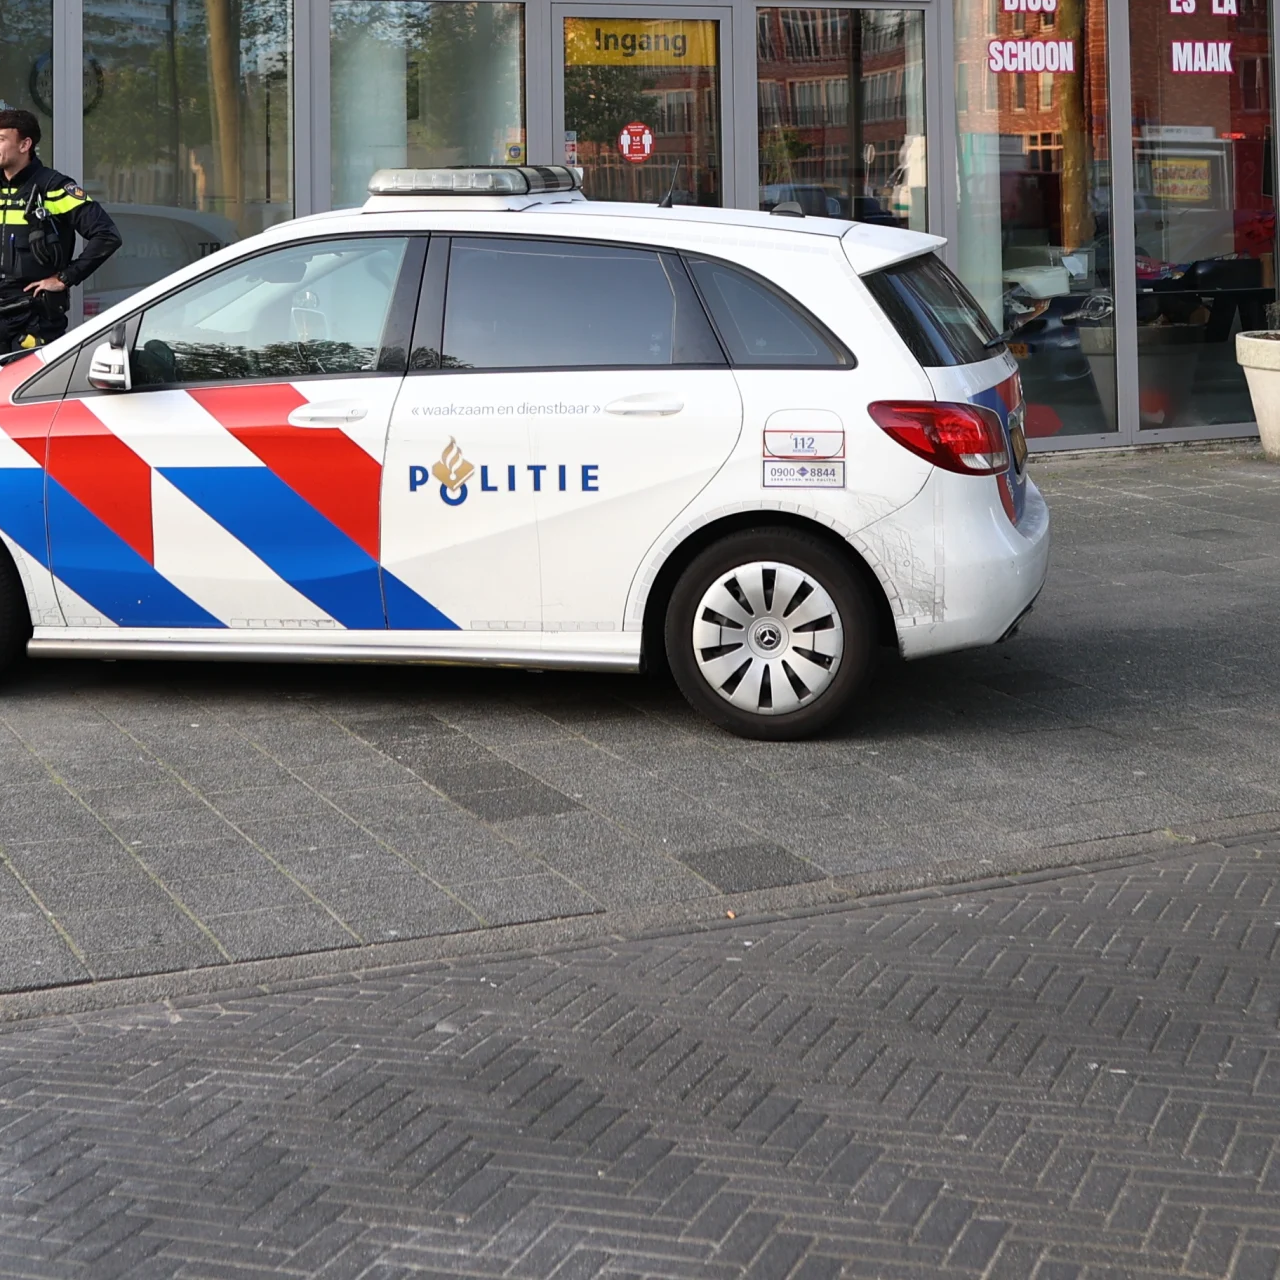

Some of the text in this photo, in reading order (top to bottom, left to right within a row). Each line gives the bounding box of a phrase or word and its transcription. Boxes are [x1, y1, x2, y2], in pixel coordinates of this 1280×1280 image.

[594, 27, 688, 58] Ingang
[988, 40, 1234, 74] SCHOON MAAK
[422, 401, 590, 416] waakzaam en dienstbaar
[408, 463, 600, 507] POLITIE
[770, 467, 836, 478] 0900 8844
